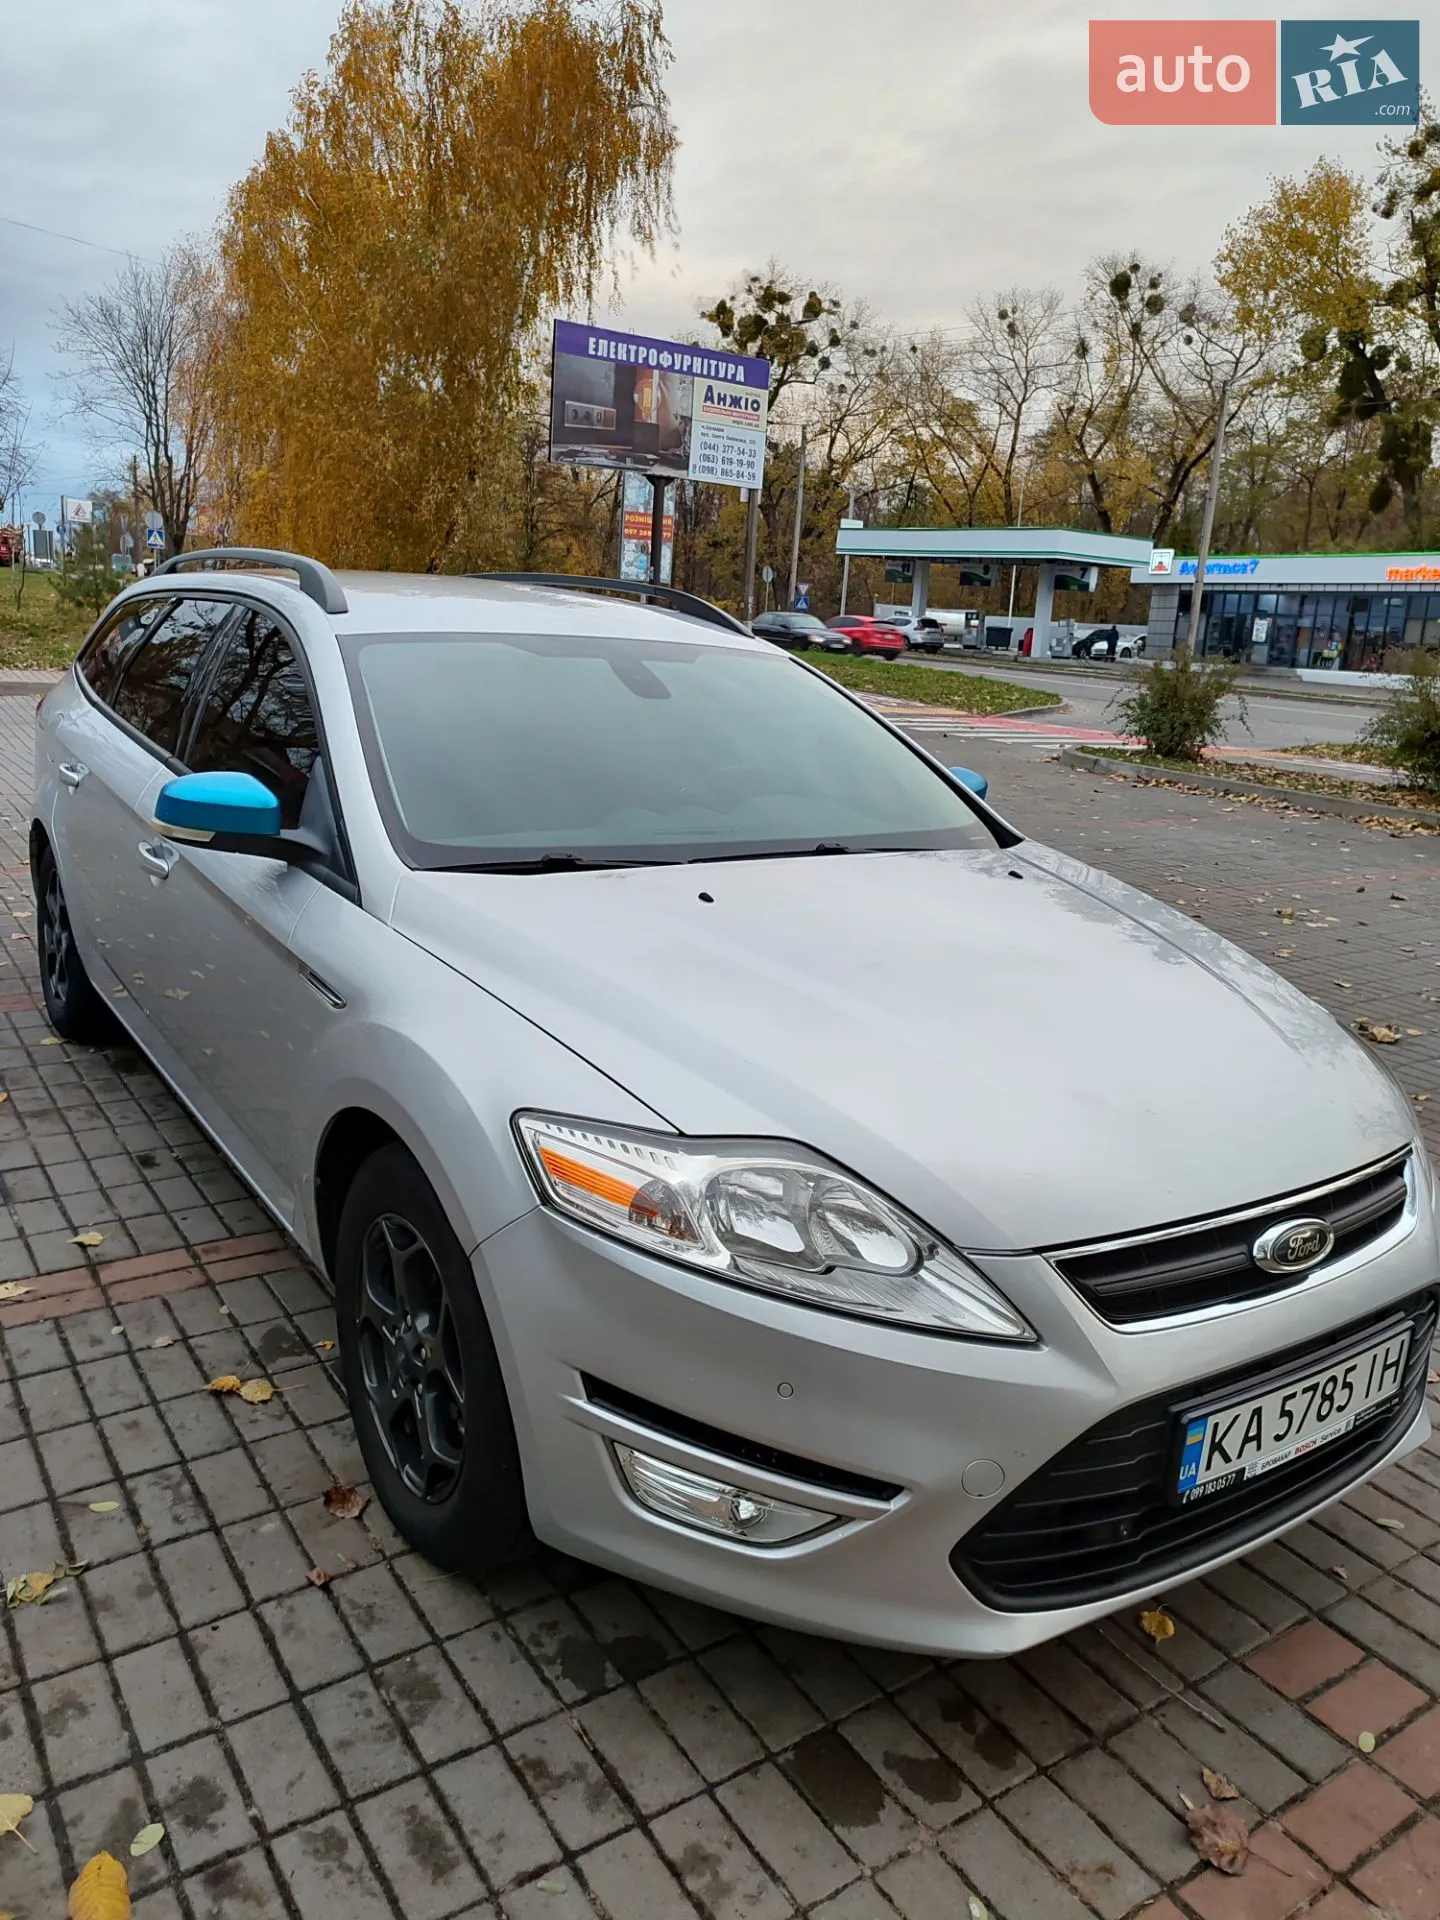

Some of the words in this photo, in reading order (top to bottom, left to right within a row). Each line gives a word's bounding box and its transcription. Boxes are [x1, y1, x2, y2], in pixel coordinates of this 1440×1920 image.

[588, 337, 745, 382] ЕЛЕКТРОФУРНІТУРА
[700, 441, 719, 453] (044)
[722, 444, 757, 458] 377-54-33
[721, 456, 756, 469] 619-19-90
[1287, 1231, 1320, 1260] Ford
[1204, 1405, 1263, 1472] KA
[1273, 1363, 1358, 1443] 5785
[1365, 1339, 1405, 1399] IH
[1180, 1461, 1196, 1480] UA
